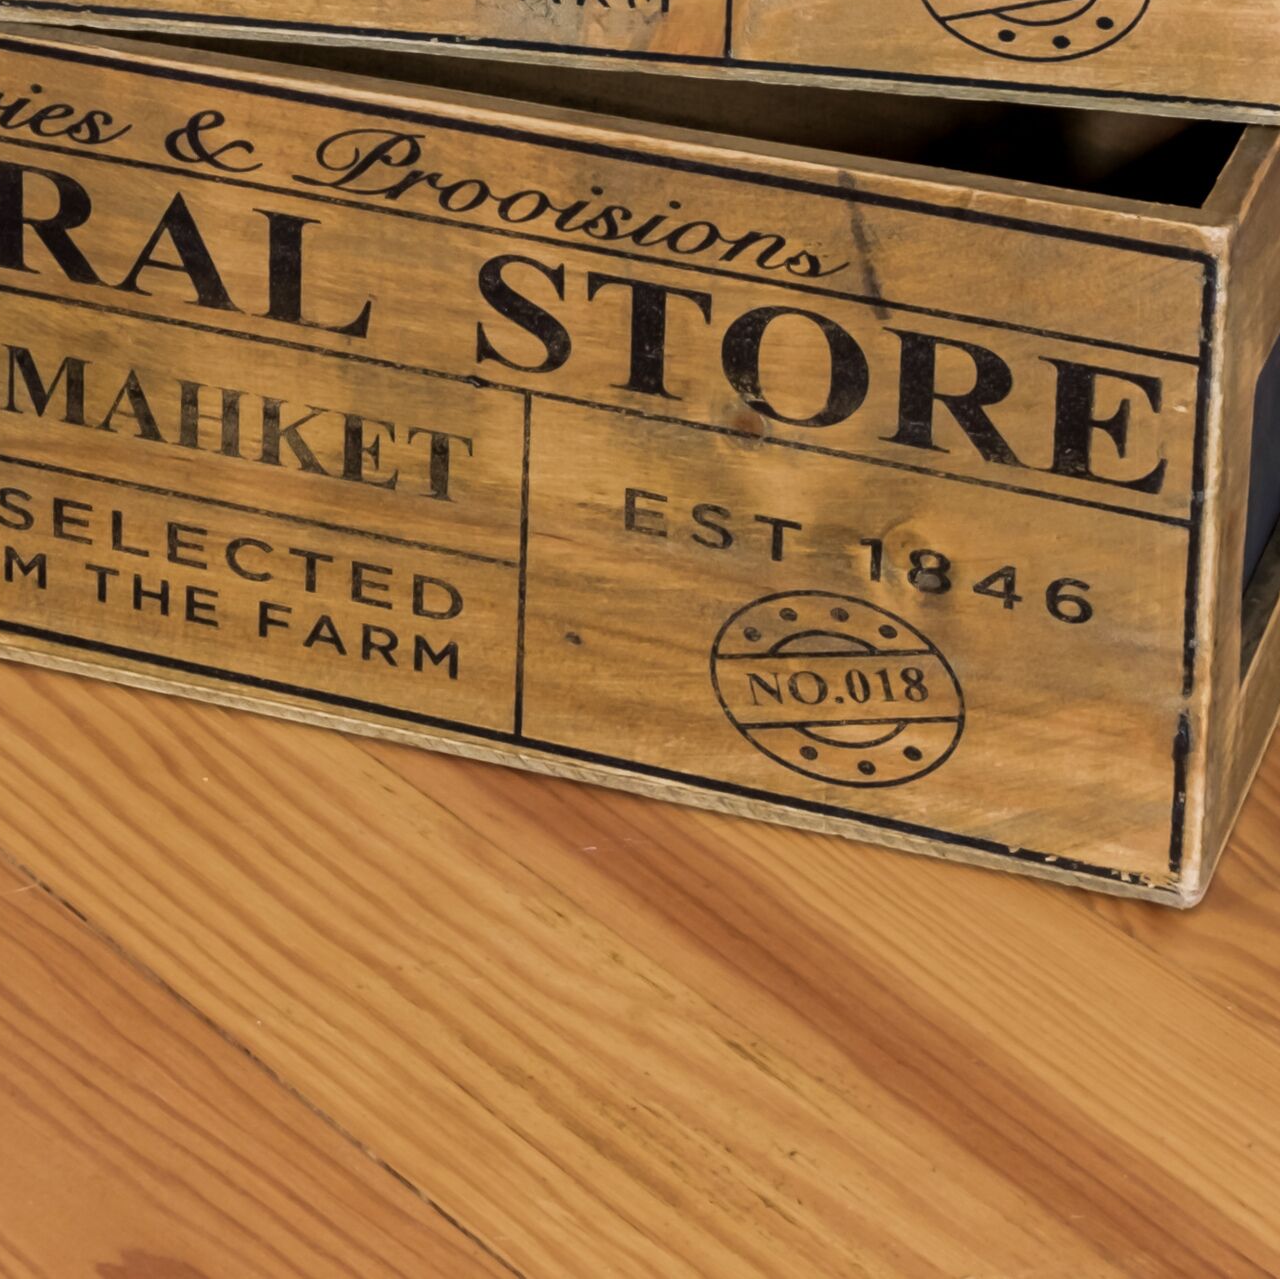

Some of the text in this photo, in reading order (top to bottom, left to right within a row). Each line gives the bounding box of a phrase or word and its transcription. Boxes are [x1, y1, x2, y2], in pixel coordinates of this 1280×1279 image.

[165, 110, 263, 172] &
[475, 253, 1168, 495] STORE
[624, 488, 1095, 627] EST 1846
[86, 562, 218, 630] THE
[258, 600, 461, 681] FARM
[746, 668, 930, 708] NO.018
